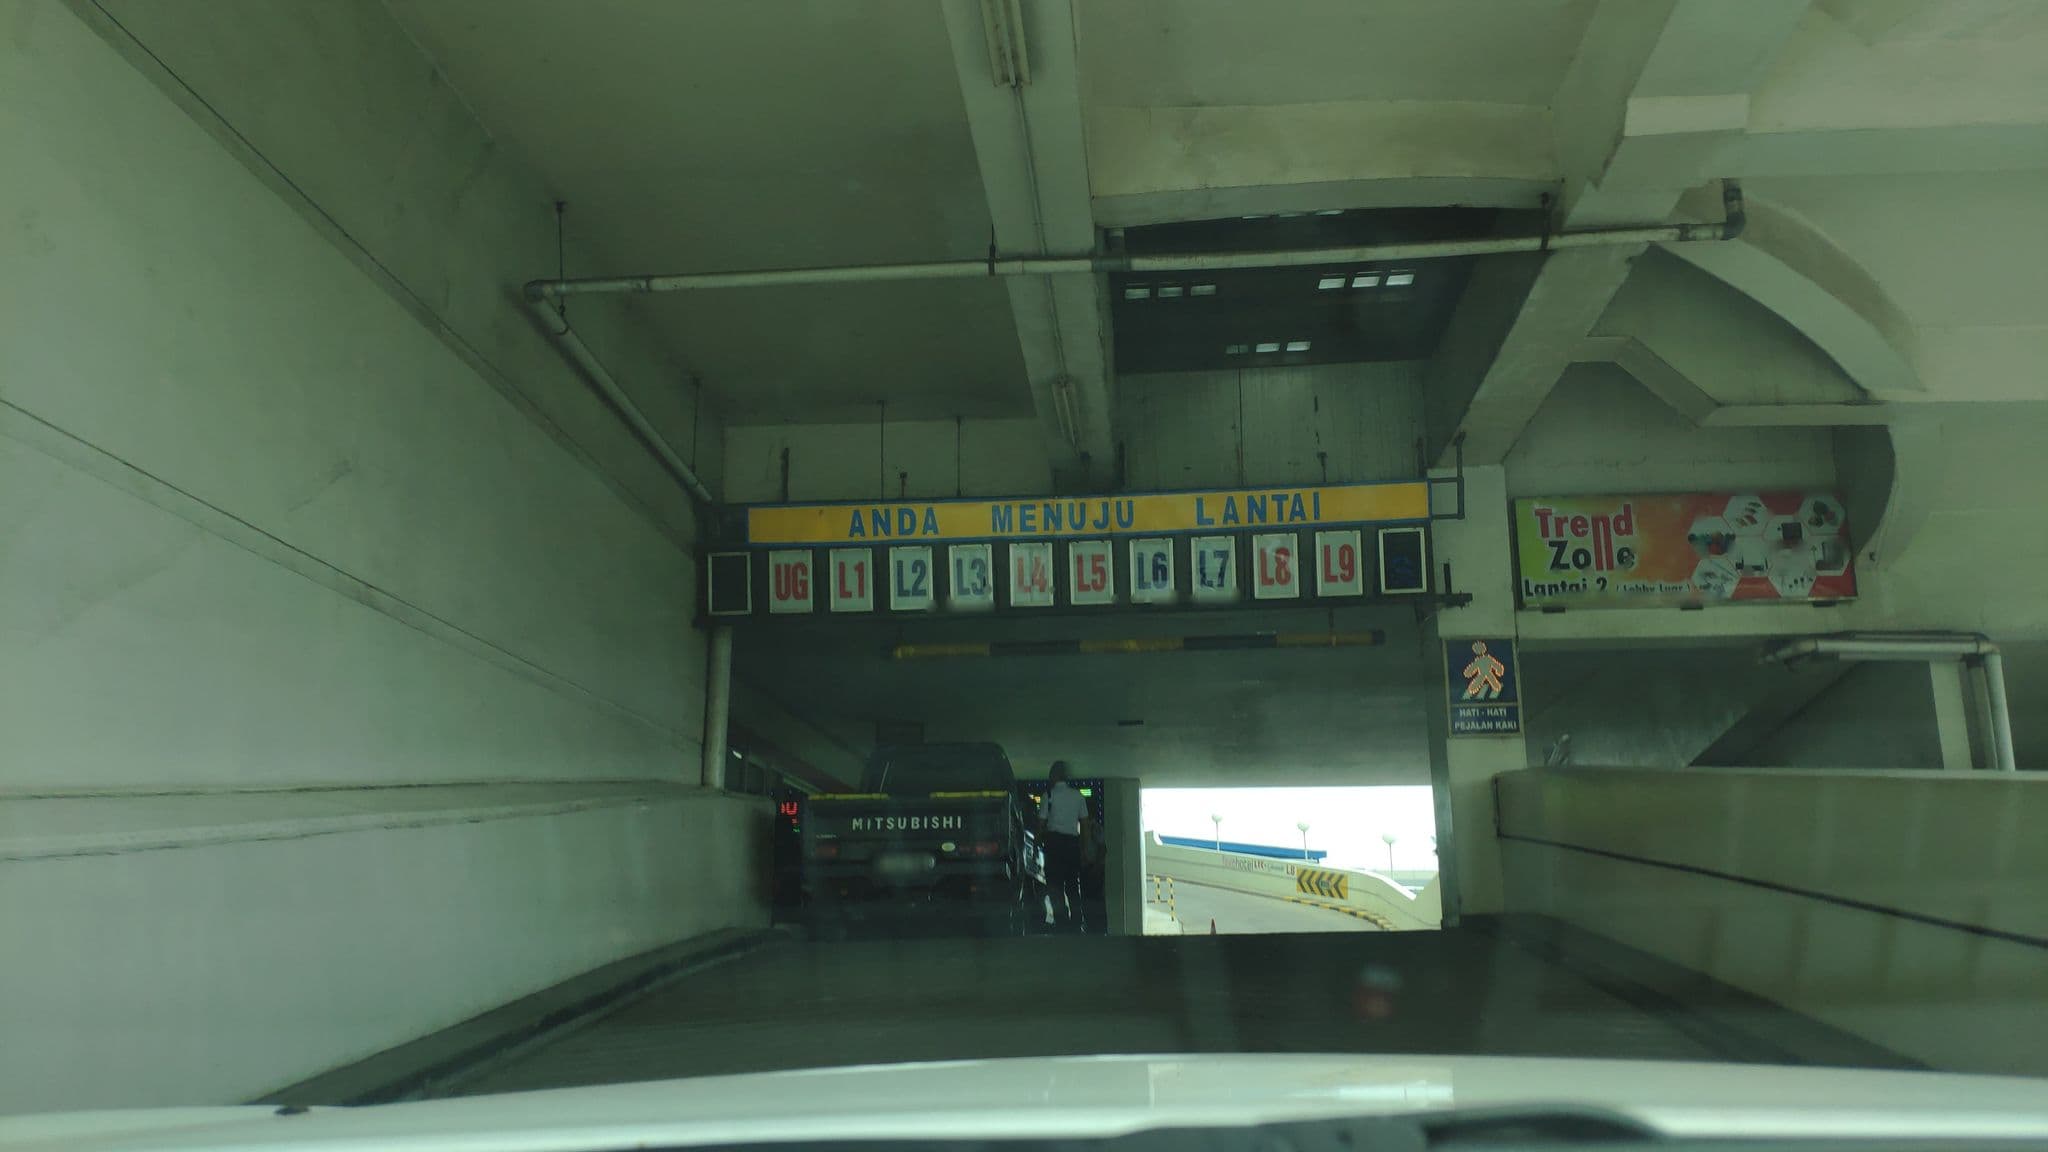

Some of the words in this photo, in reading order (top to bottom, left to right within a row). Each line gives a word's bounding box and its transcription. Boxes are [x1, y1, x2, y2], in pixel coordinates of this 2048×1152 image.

[848, 507, 939, 538] ANDA
[991, 499, 1135, 534] MENUJU
[1196, 492, 1320, 526] LANTAI
[774, 561, 809, 601] UG
[839, 560, 865, 599] L1
[896, 559, 928, 597] L2
[955, 557, 988, 596] L3
[1016, 556, 1048, 594] L4
[1076, 553, 1107, 592] L5
[1136, 551, 1169, 590] L6
[1198, 549, 1229, 588] L7
[1259, 547, 1291, 586] L8
[1323, 543, 1355, 583] L9
[1459, 707, 1479, 717] HATI
[1487, 707, 1507, 717] HATI
[1454, 721, 1494, 730] PEJALAN
[1495, 721, 1517, 730] KAKI
[851, 815, 962, 831] MITSUBISHI
